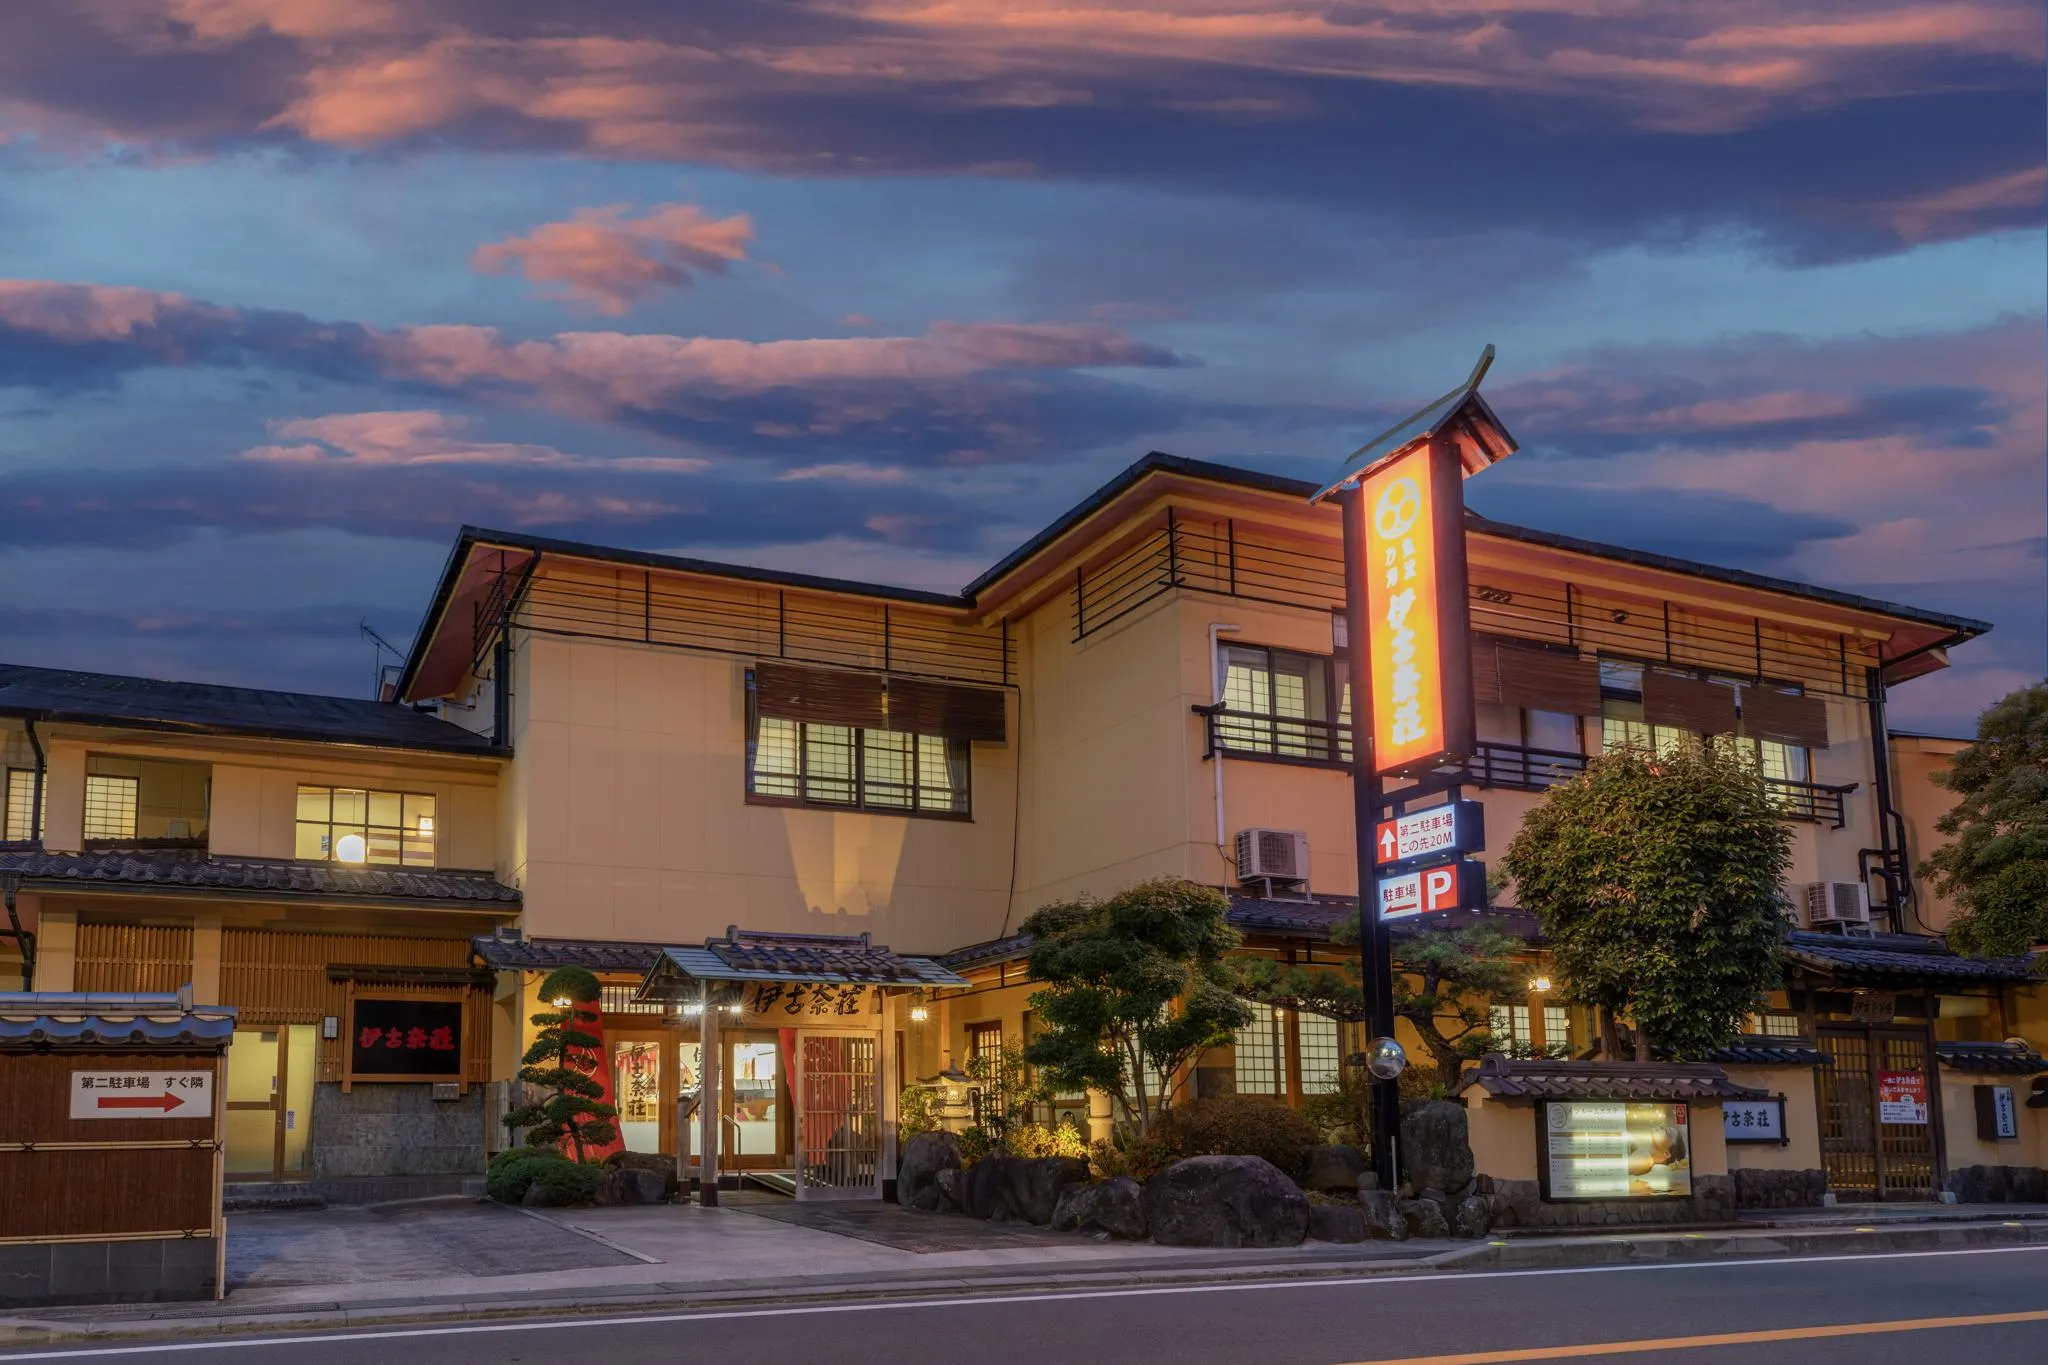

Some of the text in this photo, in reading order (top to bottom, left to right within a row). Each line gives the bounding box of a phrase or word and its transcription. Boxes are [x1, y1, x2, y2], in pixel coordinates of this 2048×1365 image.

[1400, 813, 1453, 837] 第二駐車場
[1400, 832, 1453, 854] この先20M
[1383, 884, 1416, 903] 駐車場
[1427, 870, 1452, 910] P
[754, 983, 862, 1015] 伊古奈荘
[81, 1076, 204, 1089] 第二駐車場 すぐ隣
[627, 1044, 647, 1117] 伊古奈荘
